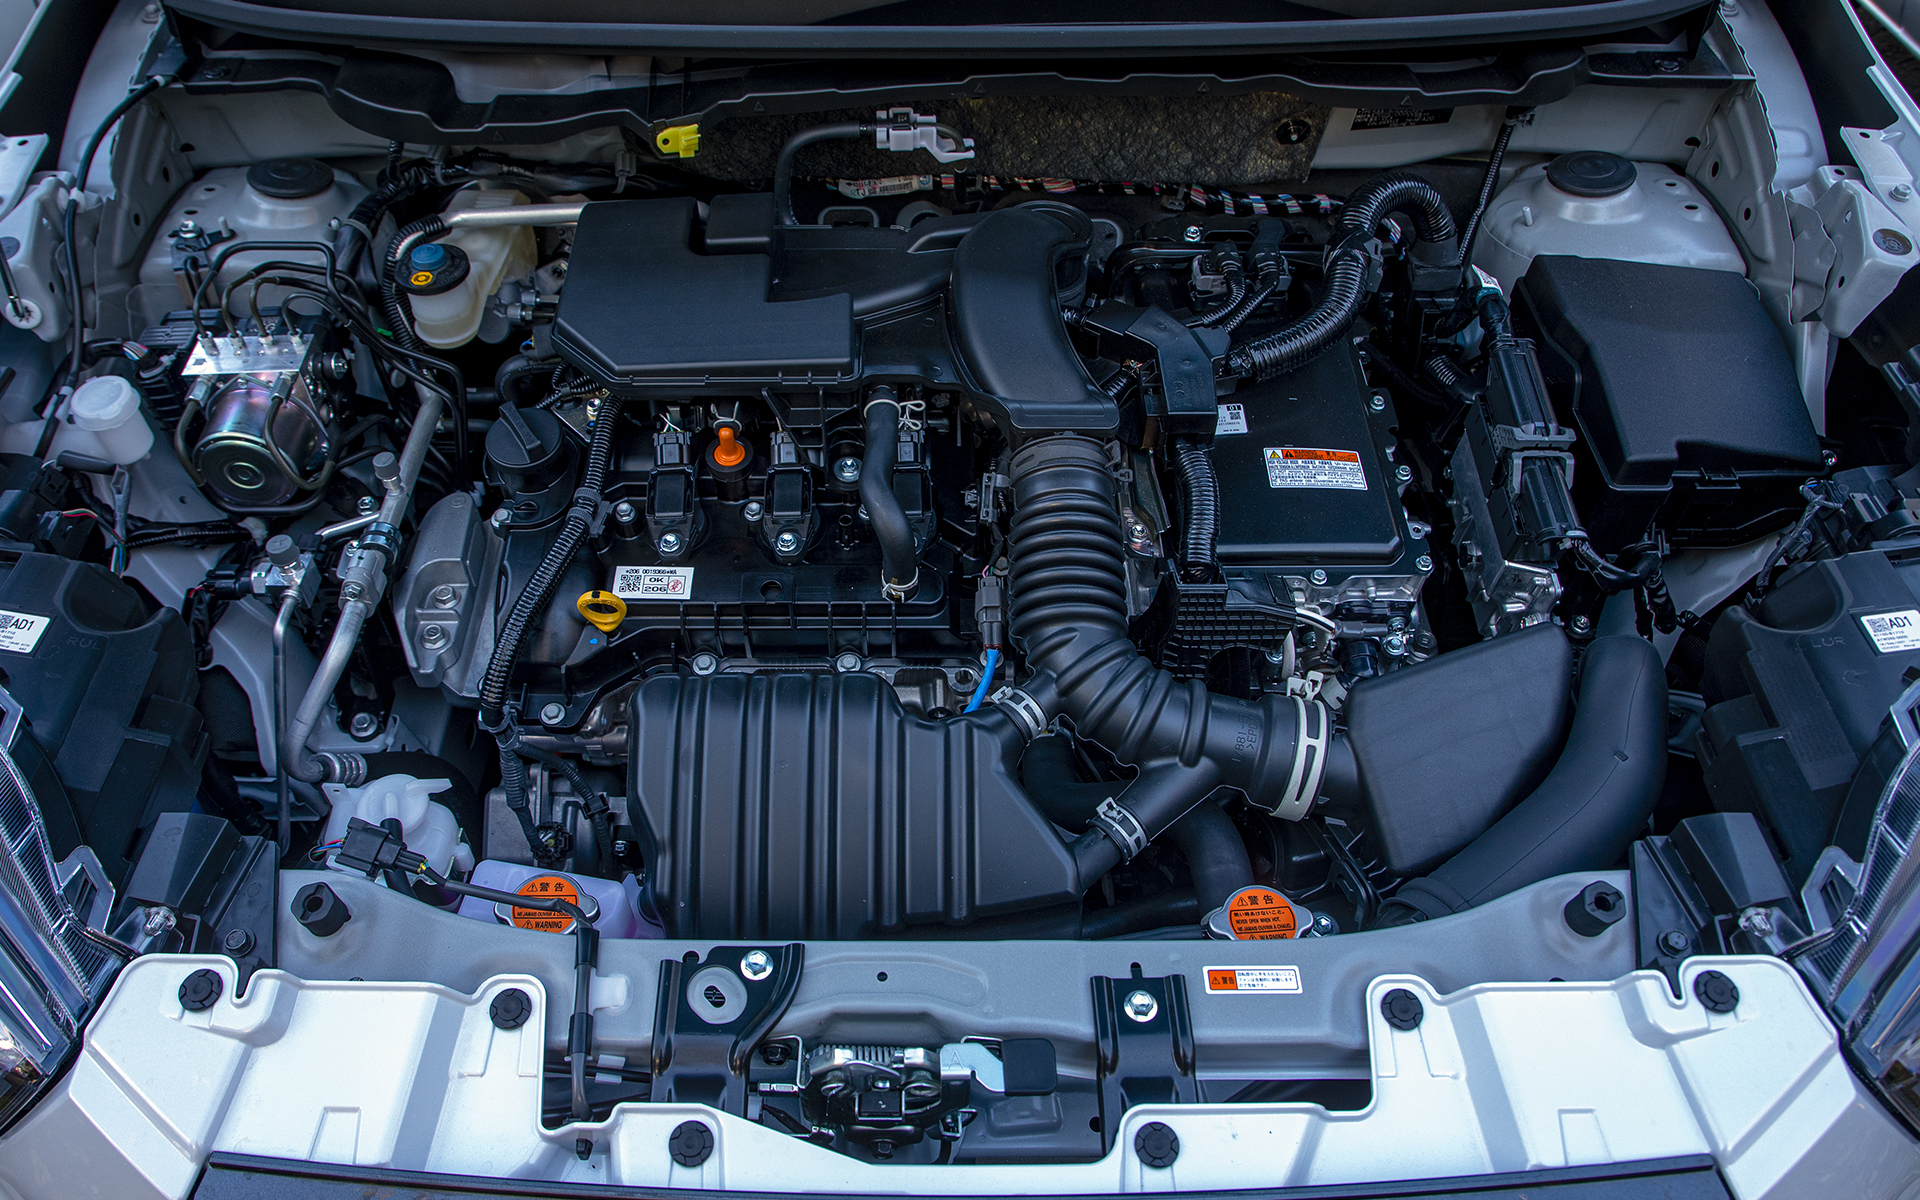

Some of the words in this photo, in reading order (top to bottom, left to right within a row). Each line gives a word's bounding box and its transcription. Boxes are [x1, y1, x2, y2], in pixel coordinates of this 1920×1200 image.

[9, 618, 35, 631] AD1
[1888, 616, 1912, 628] AD1
[540, 882, 564, 892] 警告
[1248, 895, 1274, 906] 警告
